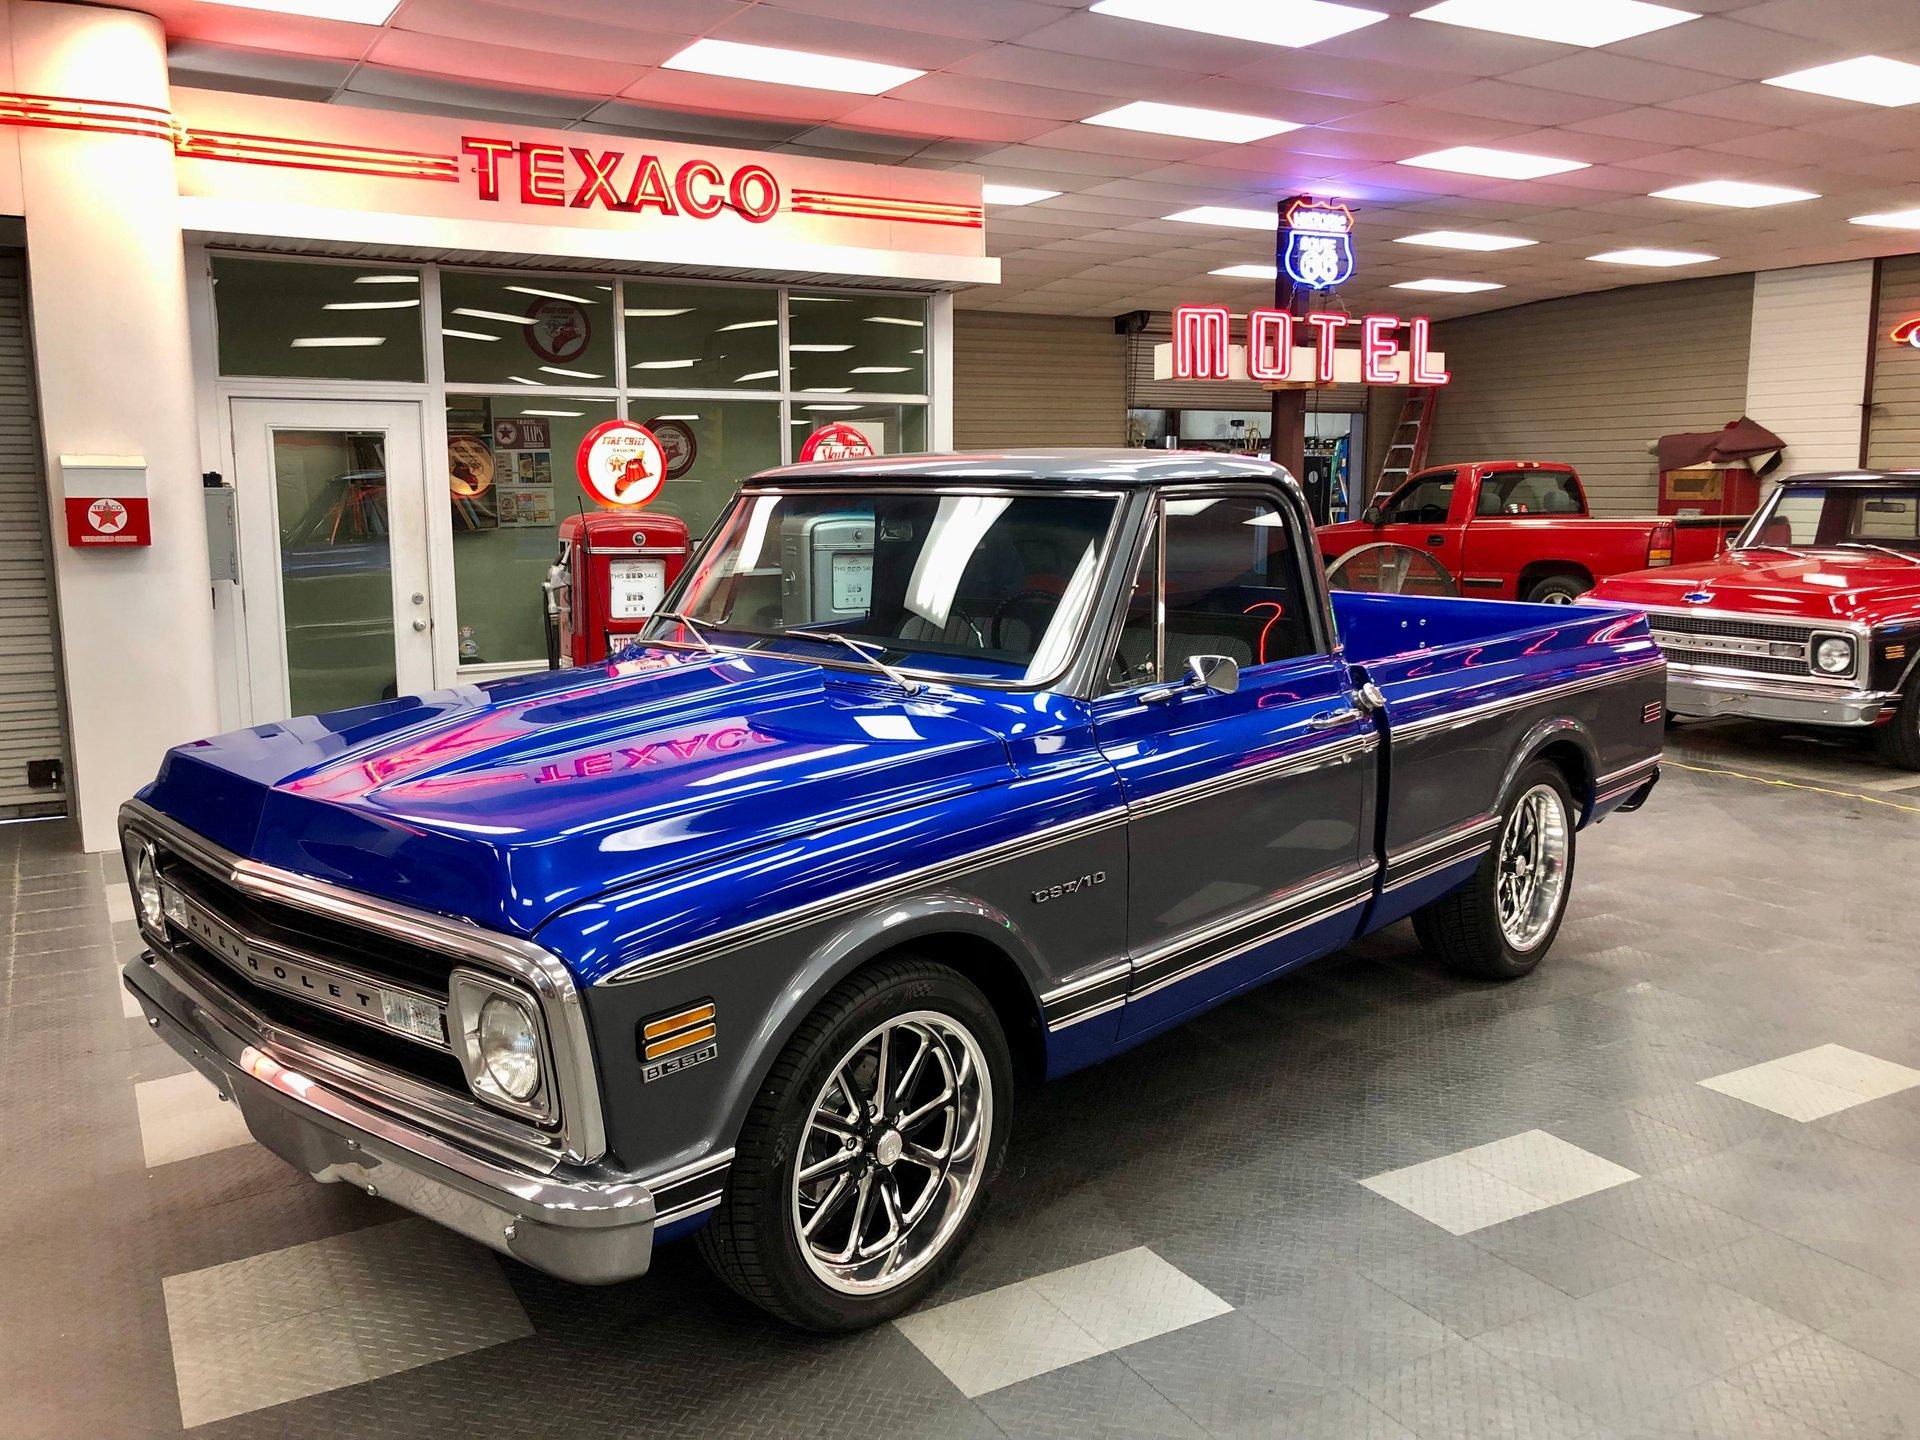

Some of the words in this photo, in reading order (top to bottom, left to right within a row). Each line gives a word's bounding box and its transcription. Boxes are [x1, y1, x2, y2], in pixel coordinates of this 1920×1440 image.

[461, 136, 781, 224] TEXACO
[1300, 250, 1339, 282] 66
[1172, 304, 1451, 384] MOTEL
[523, 425, 544, 442] MAPS
[602, 436, 647, 446] FIRE-CHIEF
[1651, 634, 1763, 651] EVROLET
[1032, 871, 1106, 903] CST/10
[190, 914, 371, 1008] CHEVROLET
